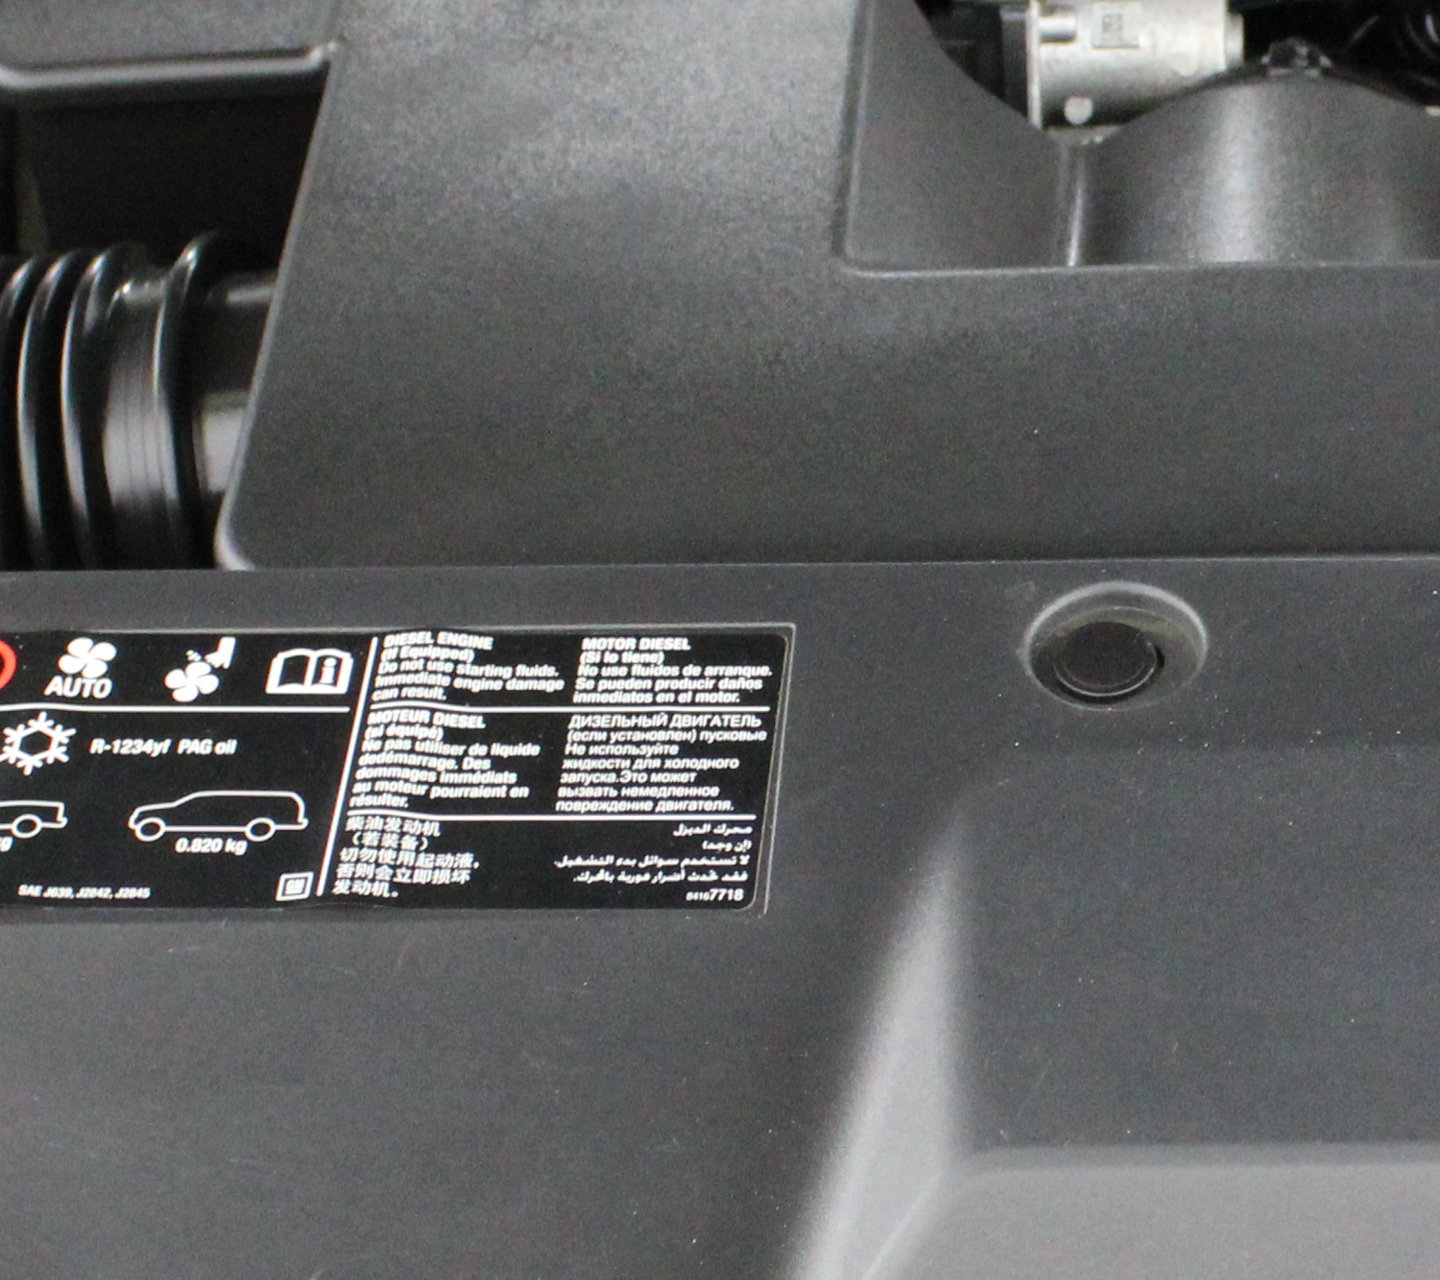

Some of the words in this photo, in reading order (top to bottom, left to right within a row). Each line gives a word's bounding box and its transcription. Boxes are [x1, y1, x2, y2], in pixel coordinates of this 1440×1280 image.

[383, 632, 434, 647] DIESEL
[437, 632, 494, 650] ENGINE
[581, 638, 636, 650] MOTOR
[639, 637, 691, 650] DIESEL
[381, 646, 397, 661] (If
[400, 645, 474, 663] Equipped)
[579, 652, 600, 665] (Si
[604, 652, 619, 663] lo
[622, 652, 665, 665] tiene)
[378, 661, 397, 674] Do
[400, 659, 424, 673] not
[427, 661, 454, 673] use
[456, 664, 512, 678] starting
[516, 664, 559, 677] fluids.
[577, 665, 598, 676] No
[601, 667, 628, 676] use
[631, 665, 679, 676] fluidos
[682, 665, 702, 676] de
[704, 666, 773, 678] arranque.
[44, 676, 113, 699] AUTO
[454, 677, 503, 692] engine
[506, 677, 565, 692] damage
[575, 678, 594, 690] Se
[598, 678, 652, 692] pueden
[655, 678, 716, 691] producir
[718, 677, 762, 690] daños
[372, 689, 397, 701] can
[401, 687, 446, 700] result.
[573, 691, 653, 703] inmediatos
[656, 693, 675, 703] en
[678, 691, 692, 703] el
[695, 692, 740, 703] motor.
[367, 710, 430, 724] MOTEUR
[433, 713, 486, 728] DIESEL
[568, 713, 668, 729] ДИЗЕЛЬНЫЙ
[670, 714, 762, 728] ДВИГАТЕЛЬ
[386, 725, 443, 741] équipé)
[567, 729, 606, 743] (если
[610, 730, 696, 743] установлен)
[700, 731, 767, 743] пусковые
[89, 738, 171, 758] R-1234yf
[177, 739, 212, 755] PAG
[215, 739, 237, 755] oil
[361, 738, 382, 752] Ne
[384, 739, 411, 753] pas
[415, 741, 466, 756] utiliser
[469, 743, 488, 756] de
[491, 743, 541, 758] liquide
[564, 744, 585, 755] Не
[589, 743, 679, 758] используйте
[462, 758, 491, 770] Des
[562, 758, 629, 770] жидкости
[632, 759, 660, 770] для
[664, 758, 739, 770] холодного
[355, 766, 437, 783] dommages
[650, 772, 697, 783] может
[352, 782, 371, 794] au
[374, 781, 428, 795] moteur
[430, 785, 508, 799] pourraient
[510, 787, 529, 798] en
[558, 786, 618, 797] вызвать
[621, 786, 720, 798] немедленное
[349, 794, 408, 808] résulter.
[555, 800, 653, 814] повреждение
[655, 800, 734, 812] двигателя.
[345, 816, 441, 836] 柴油发动机
[673, 823, 710, 836] الديزل
[713, 823, 752, 836] محرك
[175, 838, 223, 853] 0.820
[225, 838, 248, 855] kg
[336, 863, 471, 884] 否则会立即损坏
[18, 884, 42, 897] SAE
